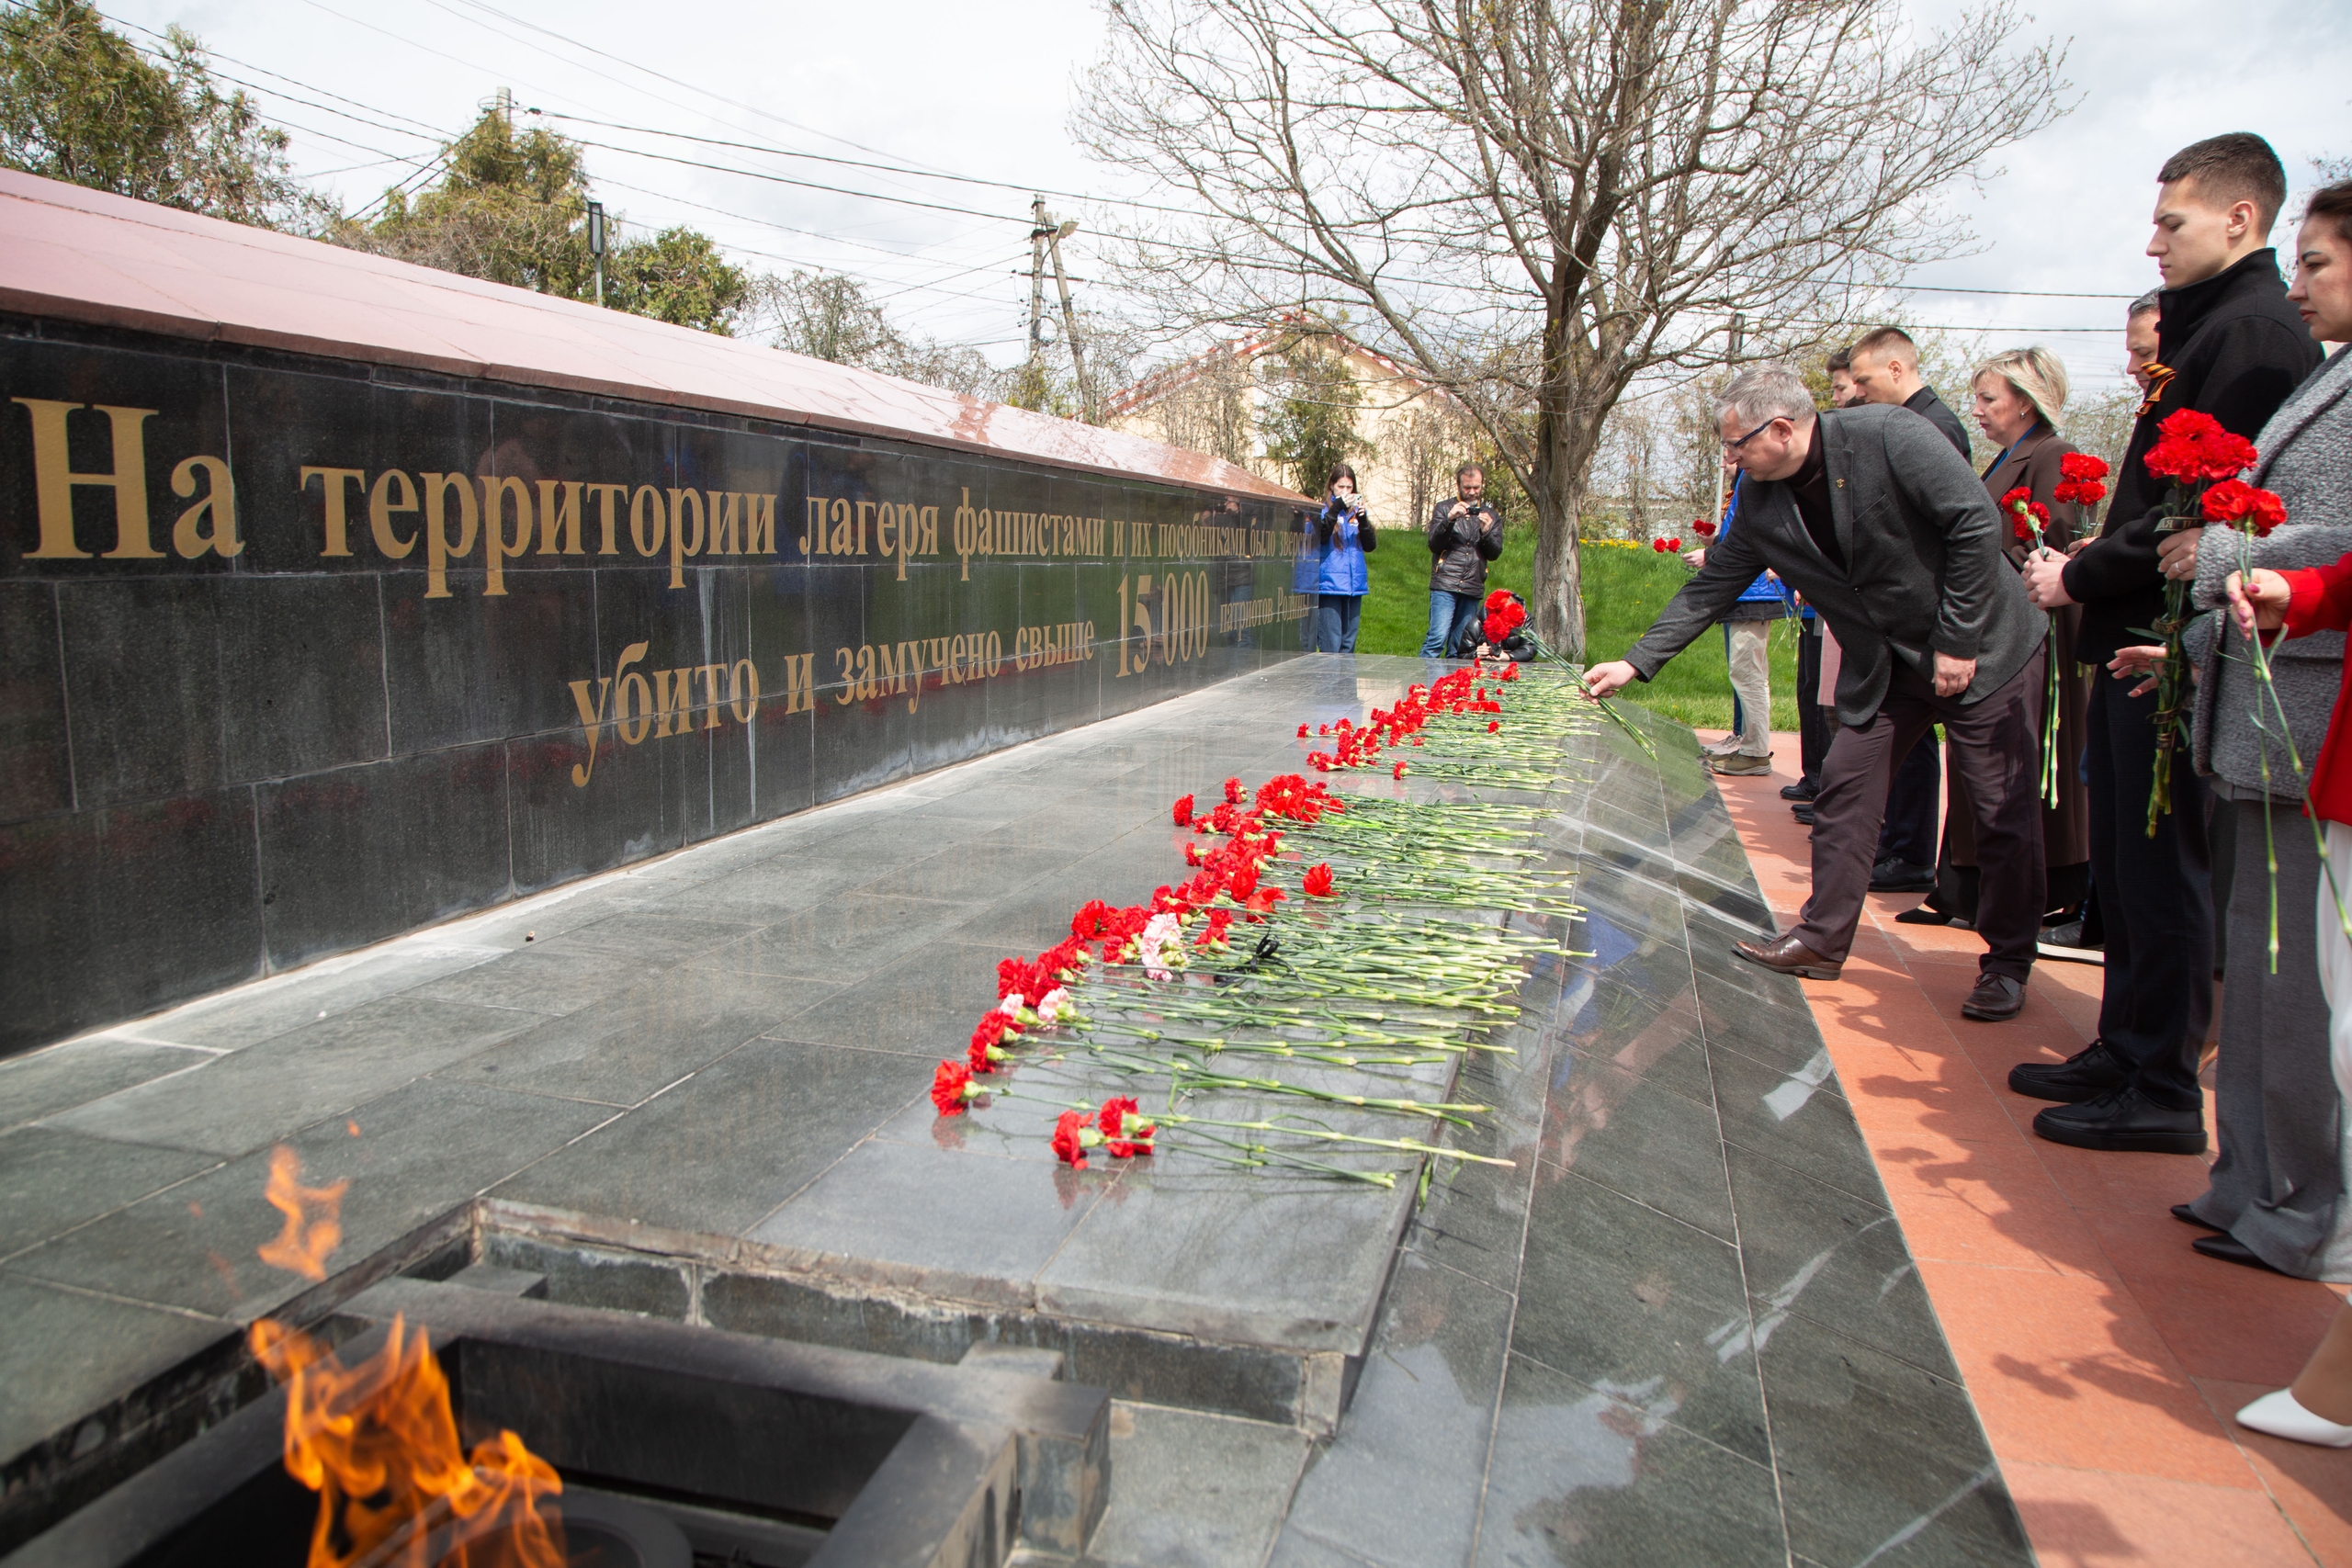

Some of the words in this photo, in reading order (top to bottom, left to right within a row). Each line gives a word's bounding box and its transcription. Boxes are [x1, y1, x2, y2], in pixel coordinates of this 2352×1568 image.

[11, 397, 246, 560] На
[300, 465, 777, 599] территории
[799, 496, 940, 581] лагеря
[954, 487, 1105, 581] фашистами
[1113, 520, 1125, 557] и
[1131, 521, 1152, 558] их
[1158, 513, 1247, 558] пособниками
[1250, 517, 1276, 558] было
[1279, 530, 1313, 567] зверски
[568, 640, 760, 788] убито
[786, 653, 814, 716] и
[835, 630, 1002, 716] замучено
[1015, 620, 1095, 671] свыше
[1219, 597, 1273, 642] патриотов
[1277, 586, 1310, 624] Родины
